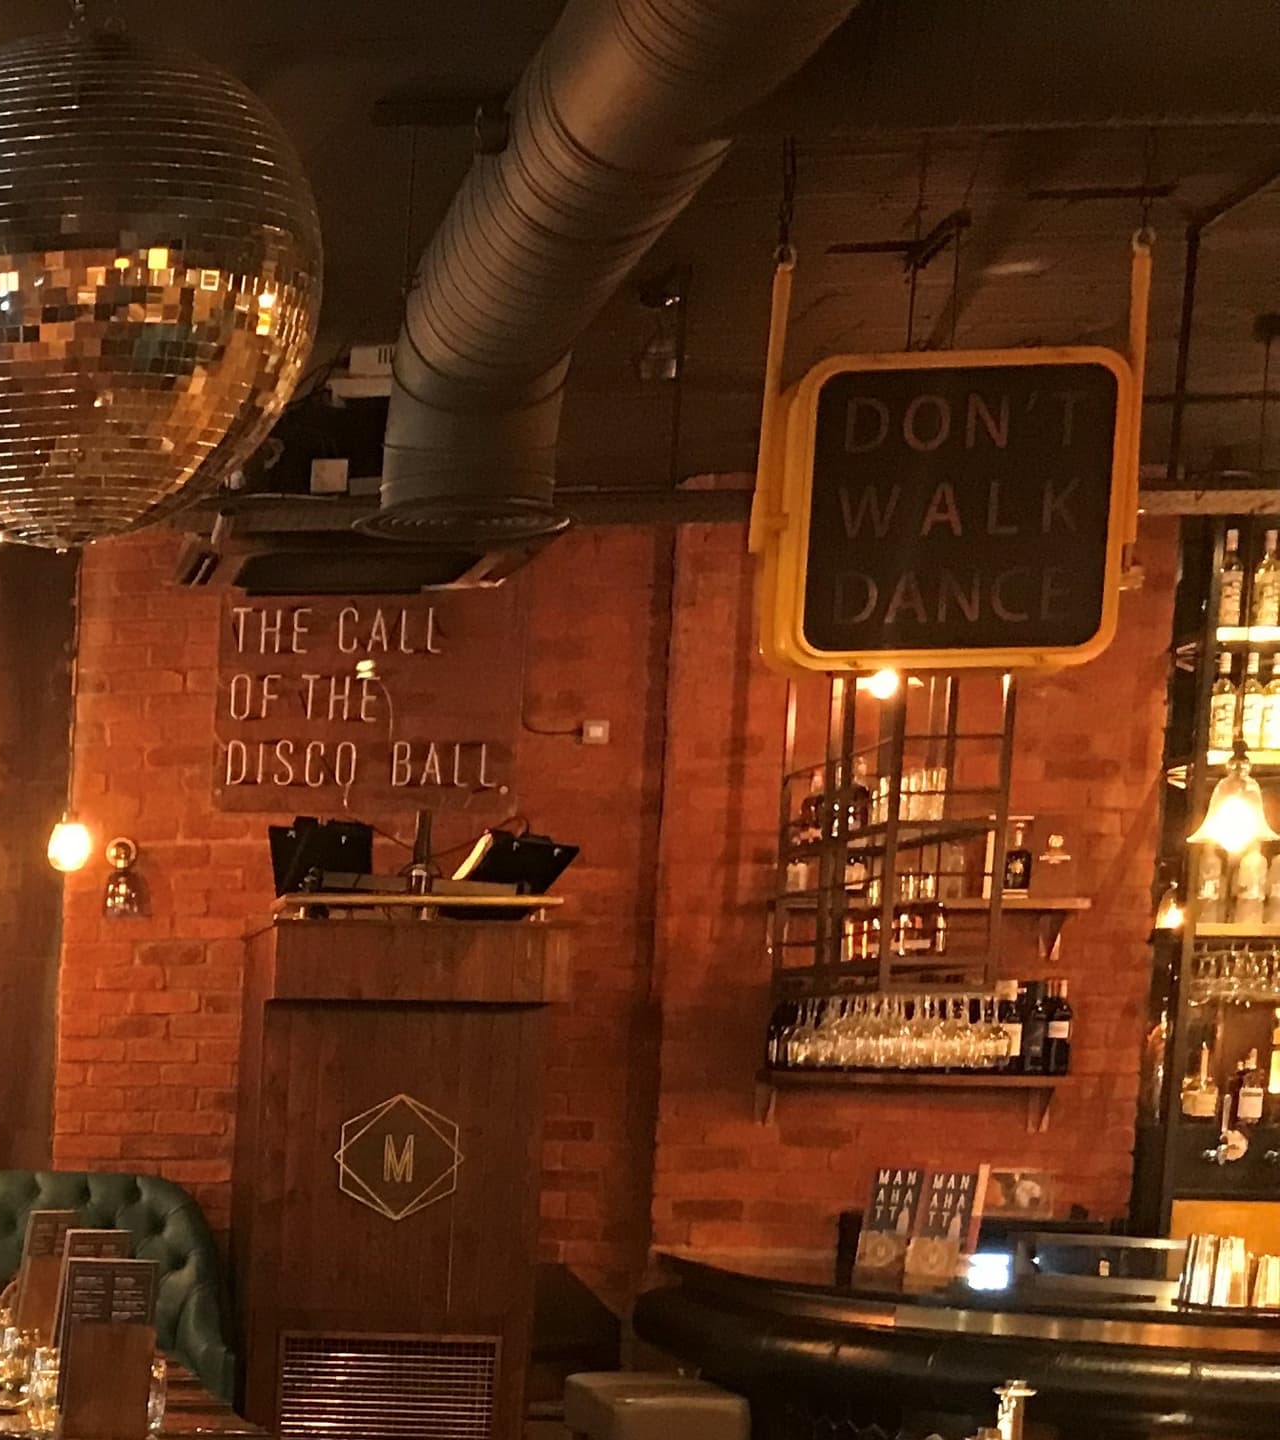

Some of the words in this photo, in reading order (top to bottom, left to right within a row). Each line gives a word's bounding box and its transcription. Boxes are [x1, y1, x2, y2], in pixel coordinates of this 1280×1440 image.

[845, 390, 1088, 452] DON'T
[839, 477, 1080, 538] WALK
[833, 566, 1072, 626] DANCE
[232, 606, 313, 654] THE
[338, 606, 442, 654] CALL
[229, 673, 282, 721] OF
[300, 674, 382, 722] THE
[225, 739, 357, 787] DISCO
[391, 740, 500, 787] BALL
[383, 1134, 415, 1183] M
[878, 1169, 917, 1185] MAN
[932, 1173, 971, 1190] MAN
[875, 1206, 898, 1220] TT
[876, 1187, 913, 1205] AHA
[928, 1211, 951, 1228] TT
[929, 1192, 965, 1209] AHA
